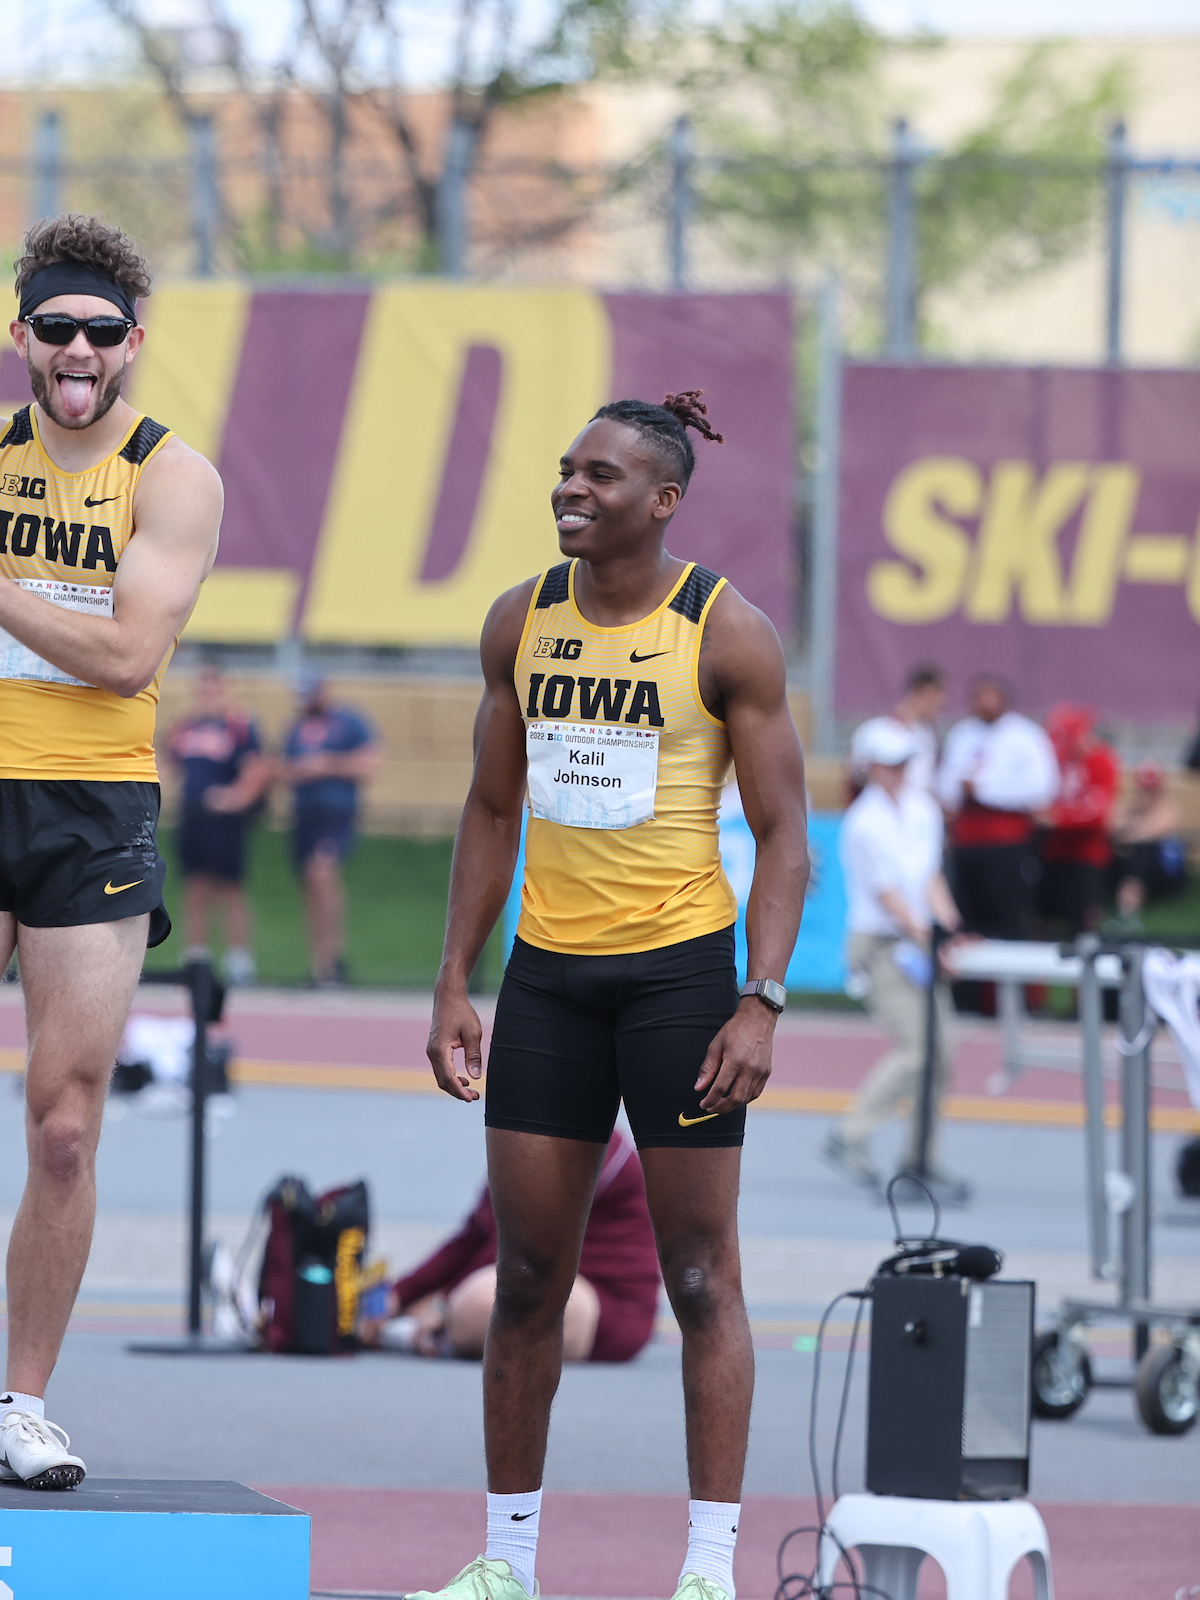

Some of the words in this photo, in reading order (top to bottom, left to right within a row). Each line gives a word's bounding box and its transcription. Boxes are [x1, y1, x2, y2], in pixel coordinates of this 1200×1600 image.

[865, 453, 1200, 629] SKI-
[53, 592, 109, 606] CHAMPIONSHIPS
[526, 673, 665, 727] IOWA
[529, 731, 545, 740] 2022
[565, 735, 595, 745] OUTDOOR
[597, 737, 655, 749] CHAMPIONSHIPS
[569, 750, 605, 767] Kalil
[553, 769, 622, 789] Johnson
